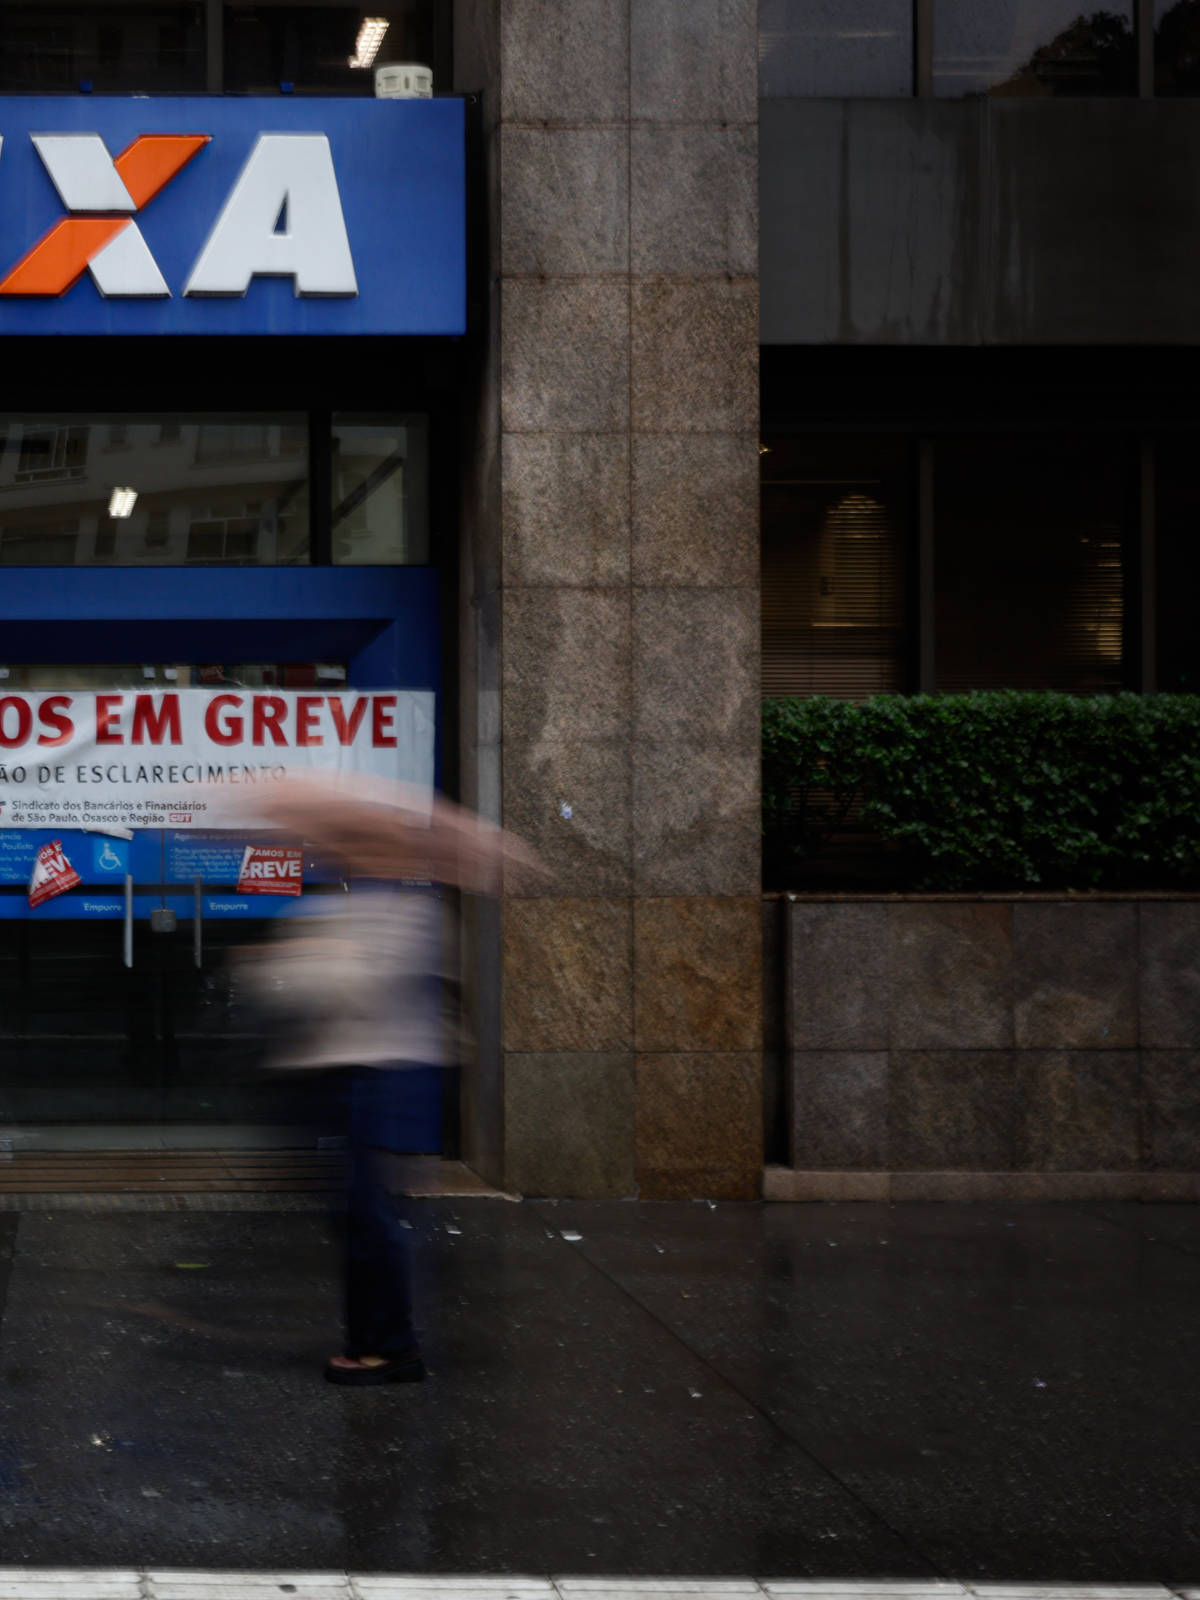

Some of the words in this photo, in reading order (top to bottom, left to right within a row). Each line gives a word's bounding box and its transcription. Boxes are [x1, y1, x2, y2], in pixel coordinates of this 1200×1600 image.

[95, 694, 183, 745] EM
[205, 694, 397, 748] GREVE
[38, 765, 65, 784] DE
[77, 765, 287, 784] ESCLARECIMENTO
[11, 799, 60, 810] Sindicato
[63, 799, 81, 810] dos
[84, 799, 134, 811] Bancários
[145, 800, 207, 811] Financiários
[11, 813, 25, 822] de
[27, 813, 47, 823] São
[82, 813, 119, 823] Osasco
[130, 812, 165, 825] Região
[83, 902, 122, 912] Empurre
[209, 901, 249, 912] Empurre
